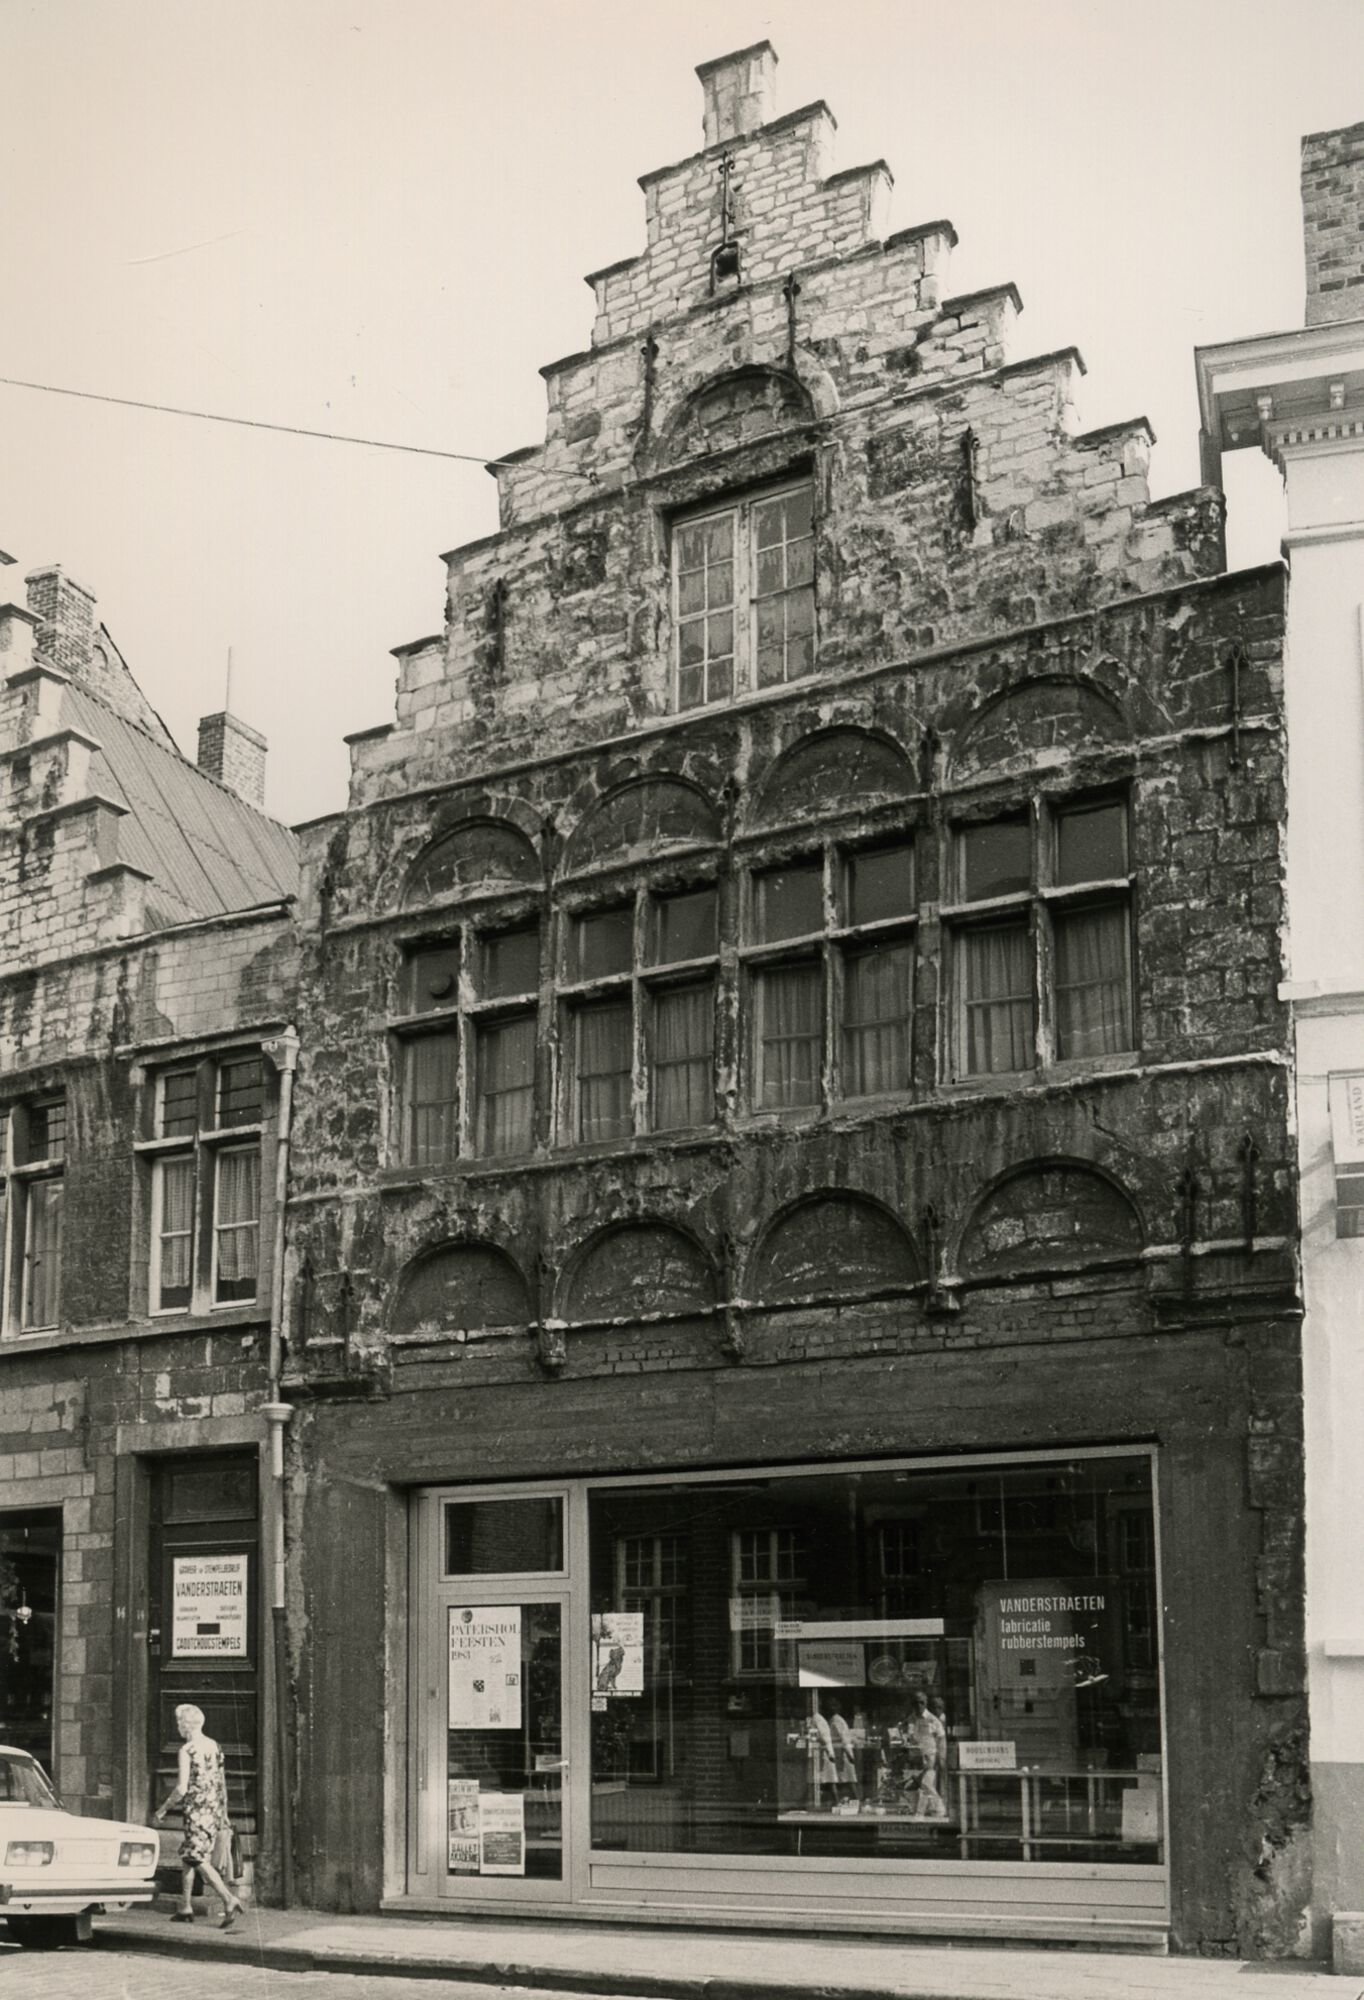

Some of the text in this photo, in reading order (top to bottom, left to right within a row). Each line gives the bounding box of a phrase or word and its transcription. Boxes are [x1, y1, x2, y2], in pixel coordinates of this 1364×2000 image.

[176, 1581, 242, 1597] VANDERSTRAETEN
[1000, 1595, 1105, 1613] VANDERSTRAETEN
[451, 1623, 521, 1636] PATERSHOL
[1001, 1618, 1051, 1633] fabricatie
[451, 1636, 506, 1649] FEESTEN
[1001, 1633, 1086, 1650] rubberstempels
